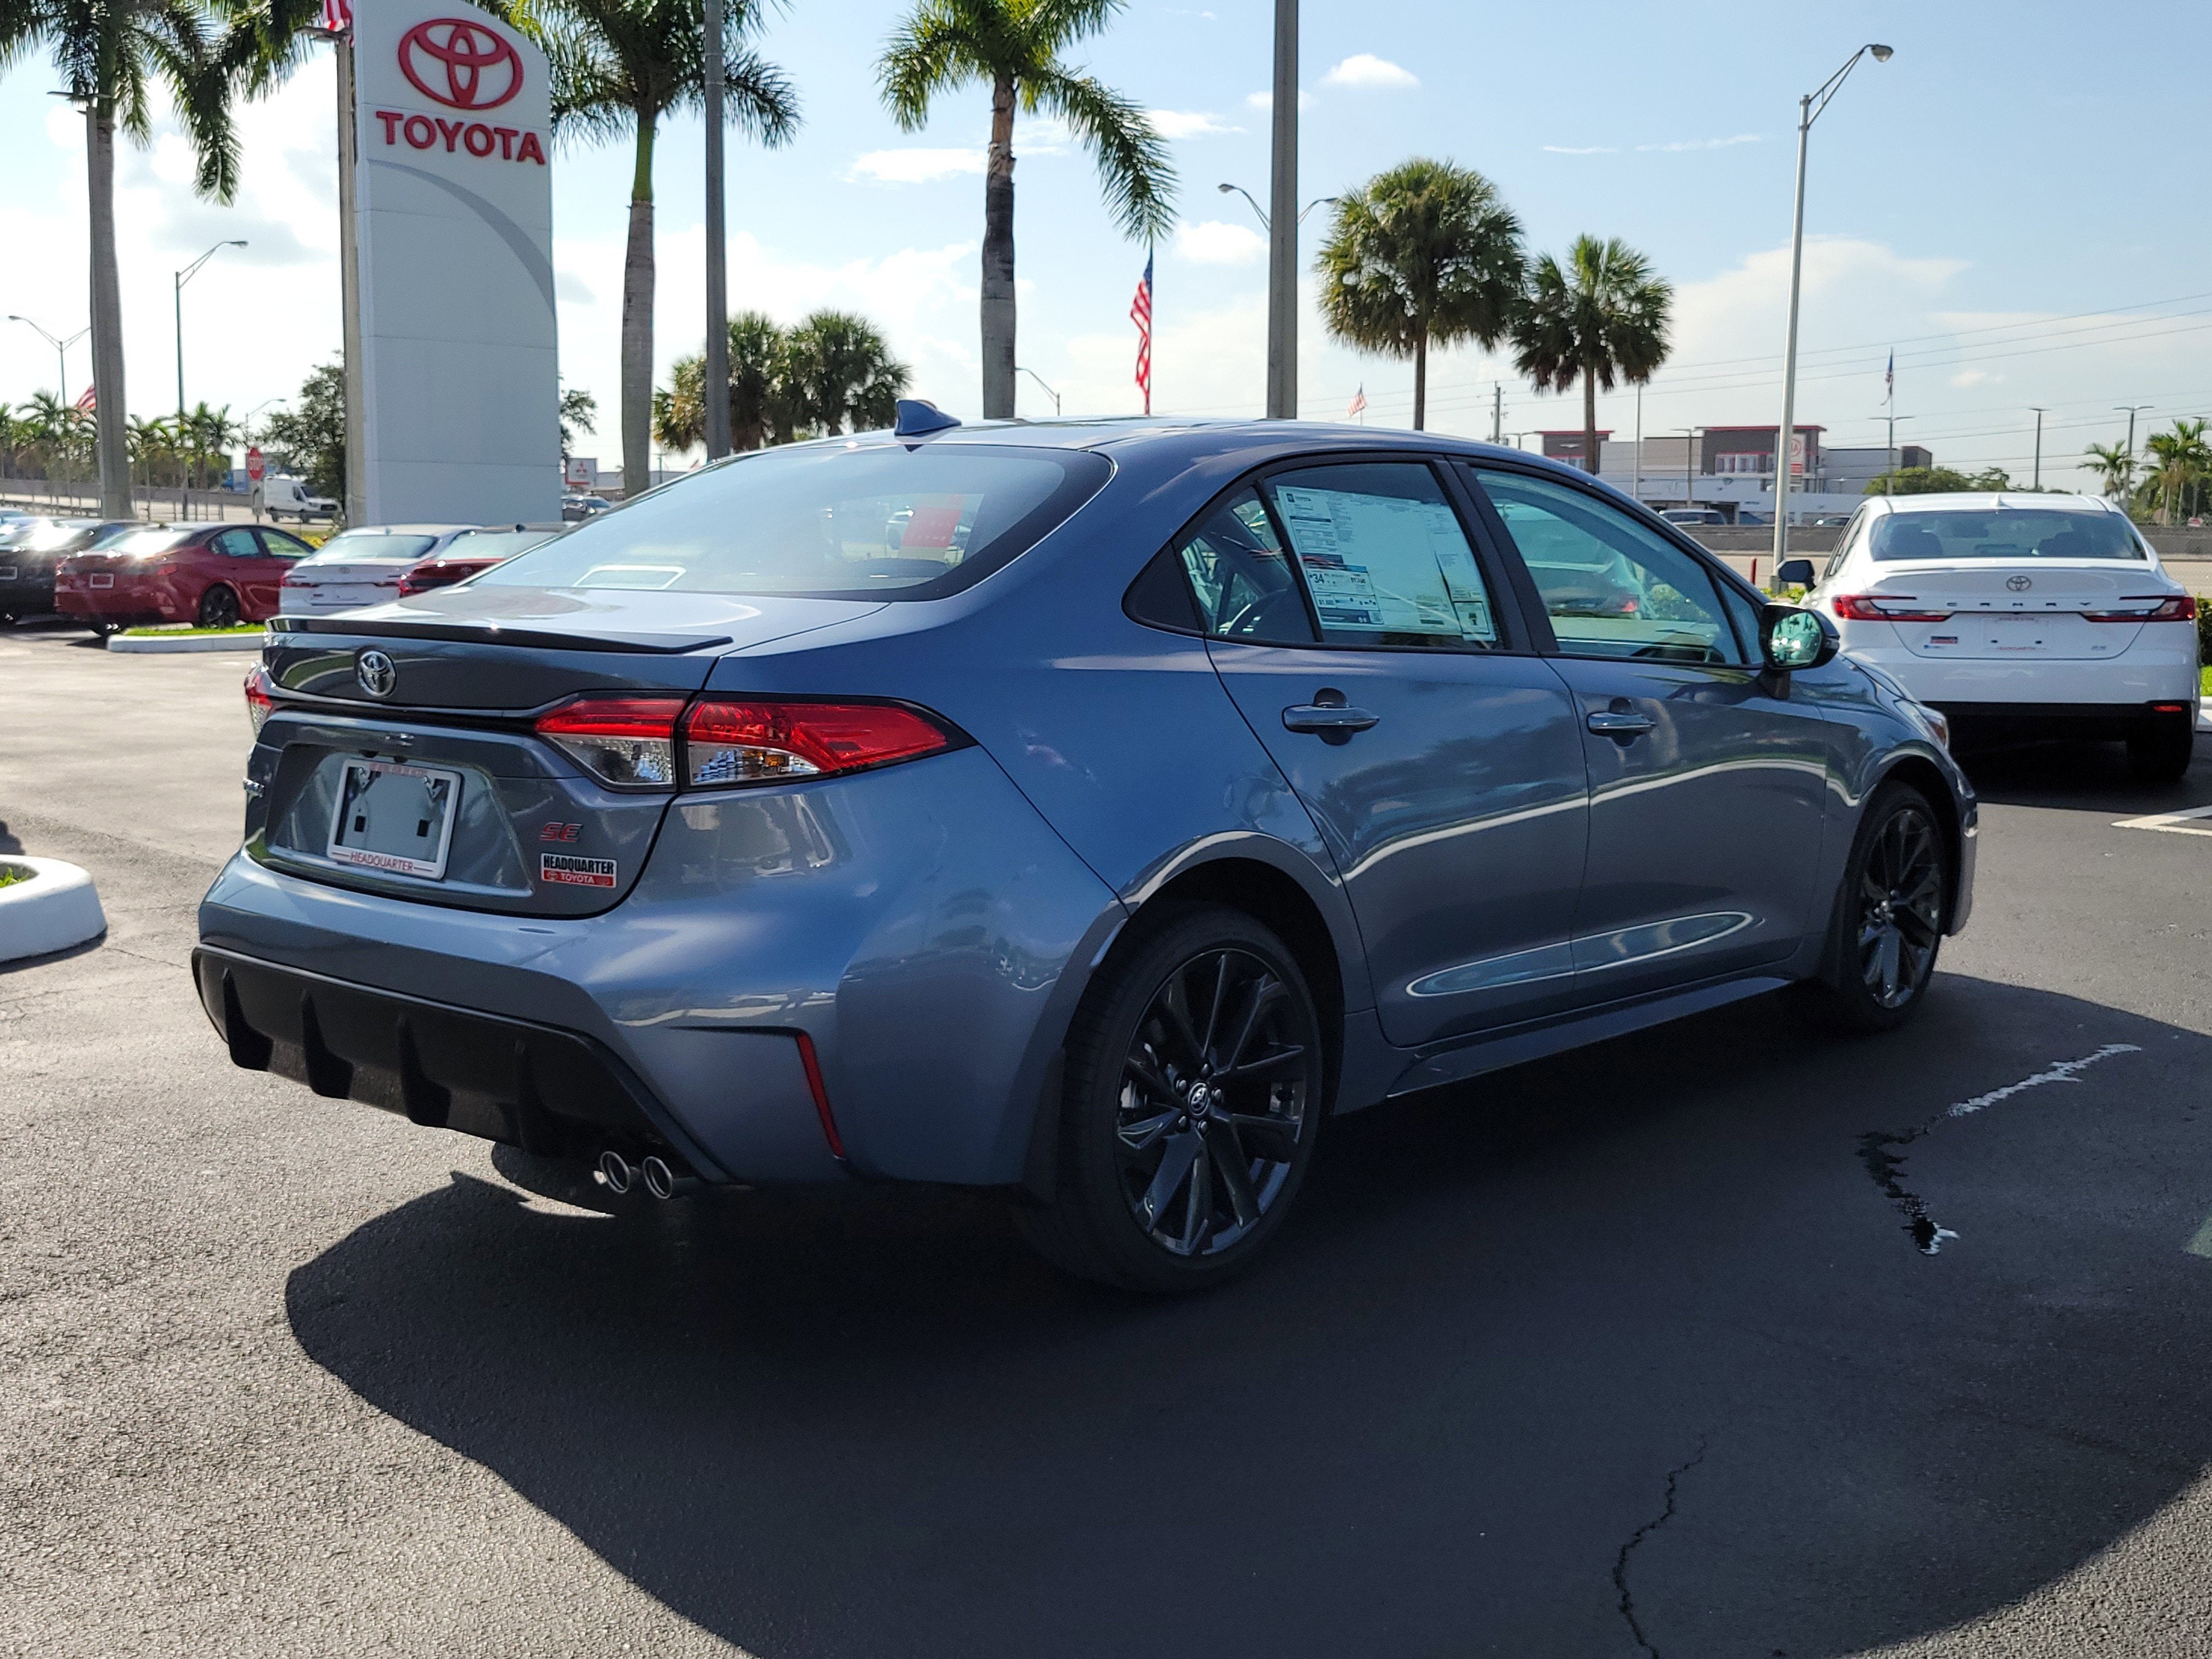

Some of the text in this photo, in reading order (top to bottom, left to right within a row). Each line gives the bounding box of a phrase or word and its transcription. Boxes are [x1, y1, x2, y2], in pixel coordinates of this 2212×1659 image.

[376, 111, 545, 165] TOYOTA
[540, 822, 583, 843] SE
[351, 851, 414, 872] HEADQUARTER
[543, 855, 614, 875] HEADQUARTER
[560, 873, 595, 884] TOYOTA
